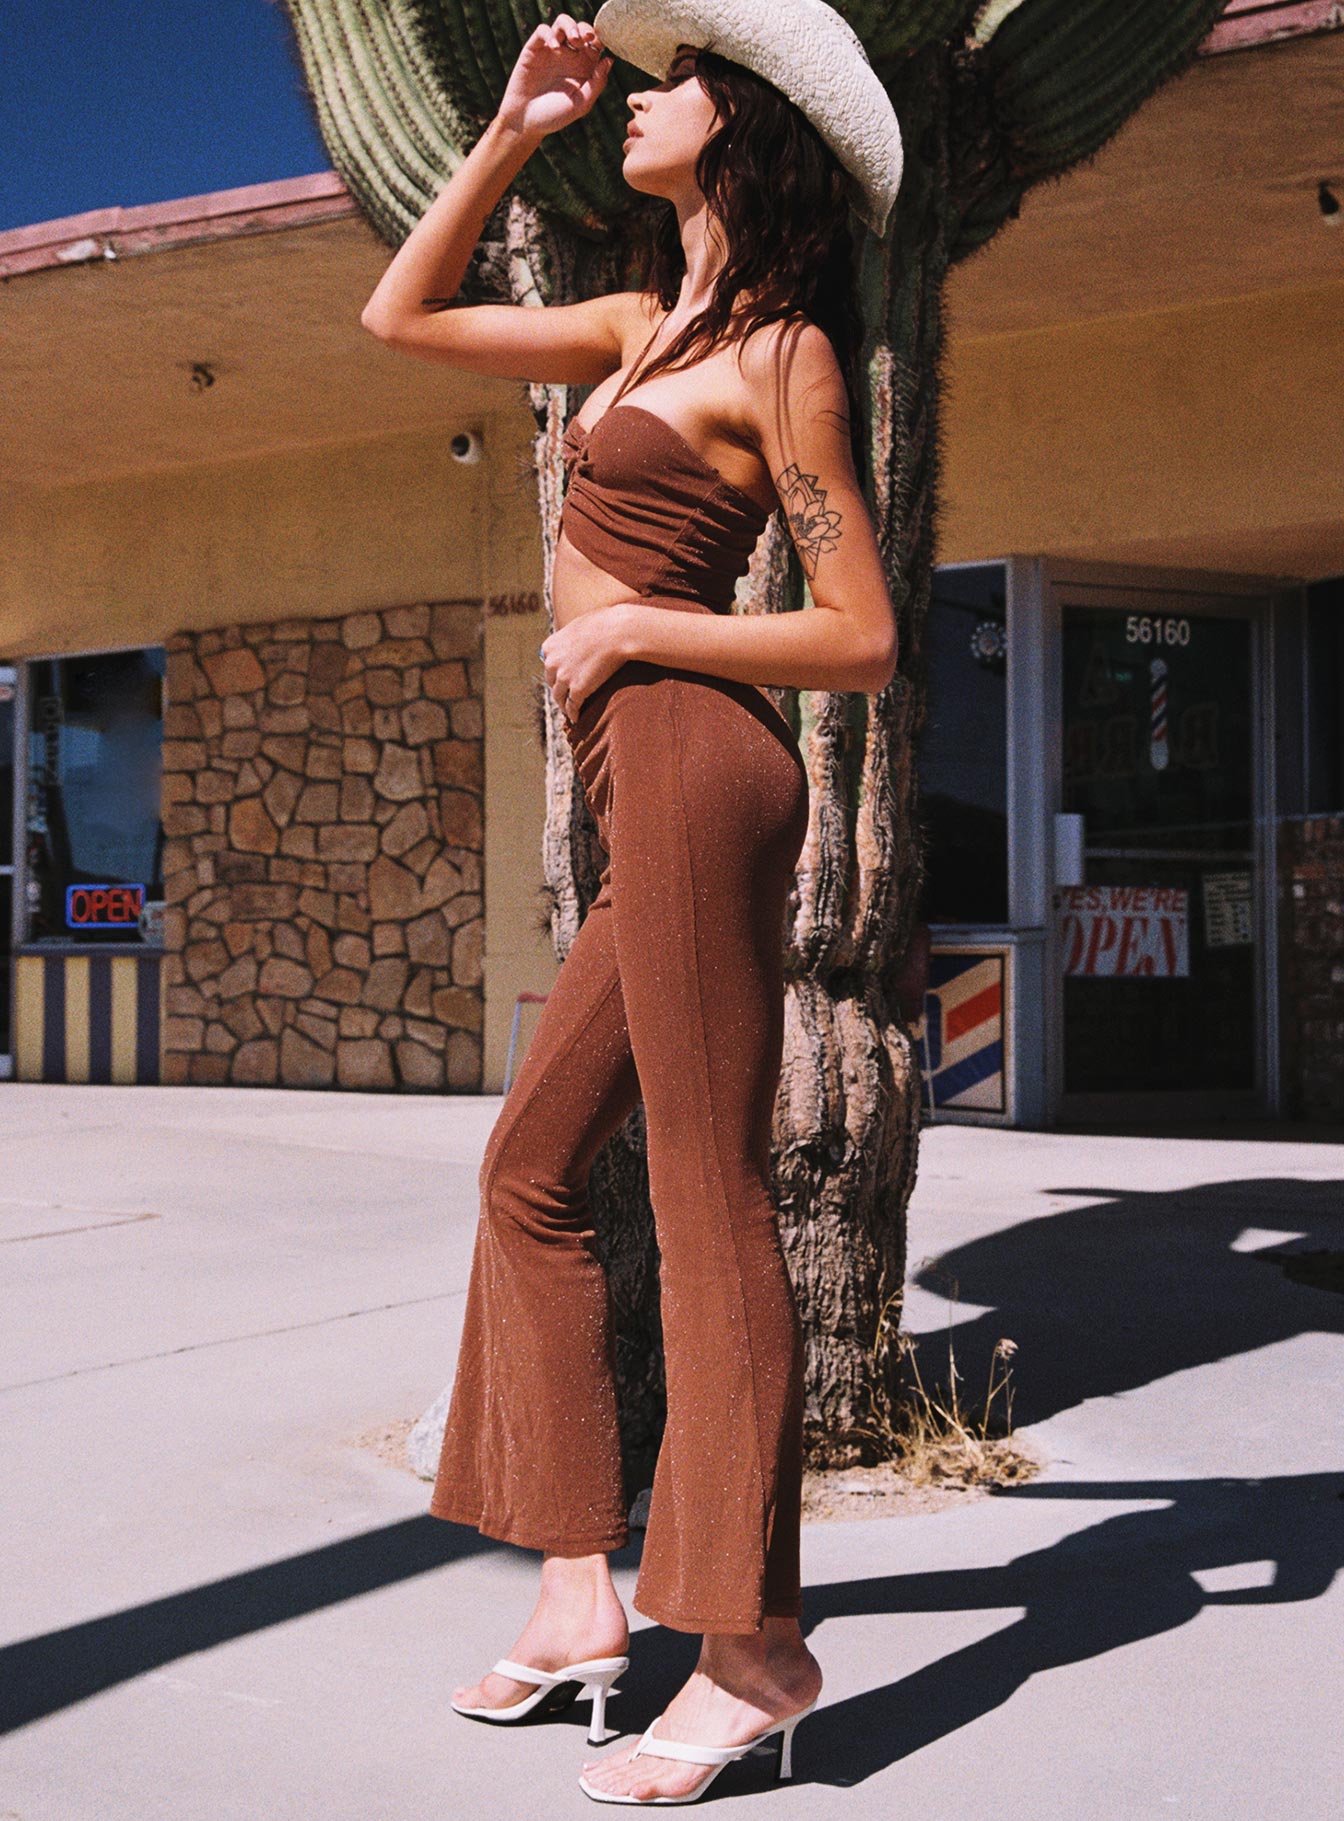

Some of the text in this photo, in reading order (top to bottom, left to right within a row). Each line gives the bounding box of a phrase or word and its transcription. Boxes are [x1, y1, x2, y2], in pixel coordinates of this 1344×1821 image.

[489, 591, 540, 616] 56160
[1126, 616, 1190, 646] 56160
[72, 889, 143, 922] OPEN
